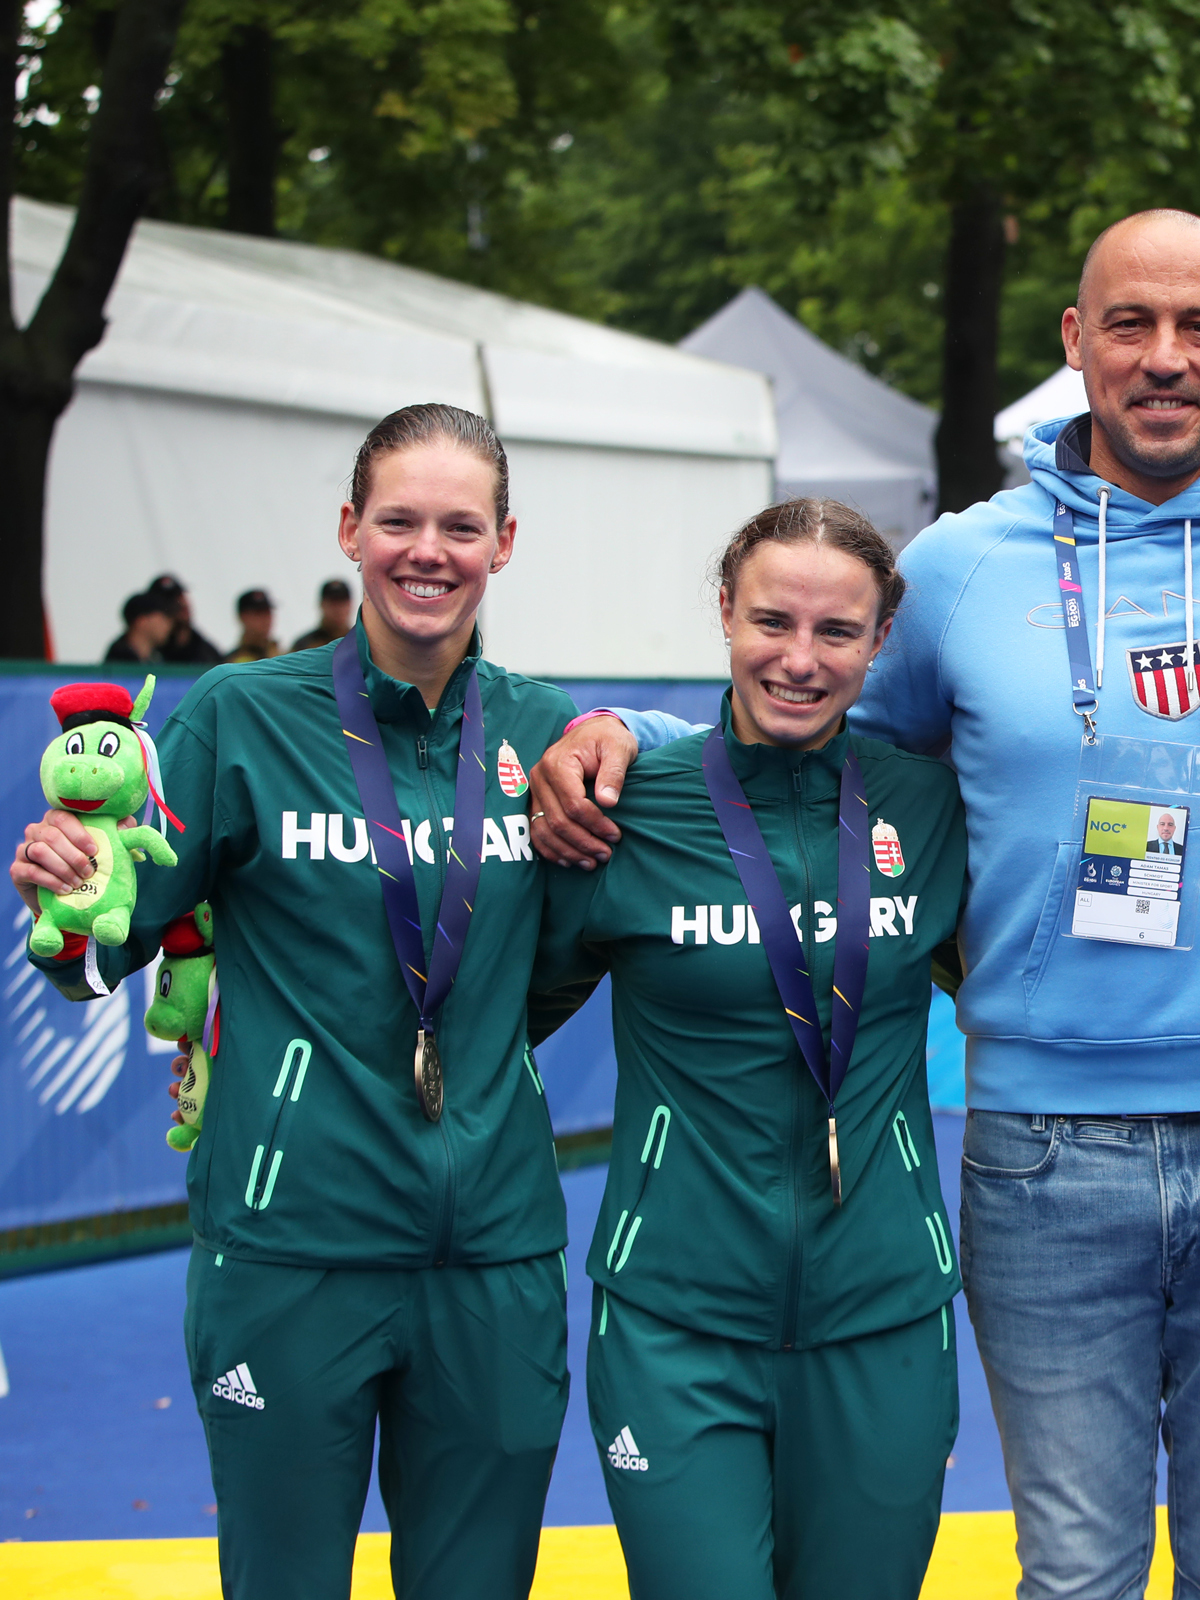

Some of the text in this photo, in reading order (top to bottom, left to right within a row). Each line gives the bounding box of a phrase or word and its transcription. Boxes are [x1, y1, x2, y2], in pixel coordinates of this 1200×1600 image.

[281, 810, 533, 866] HUGAR
[671, 895, 918, 945] HUGRY
[1138, 931, 1145, 939] 6
[212, 1383, 266, 1411] adidas
